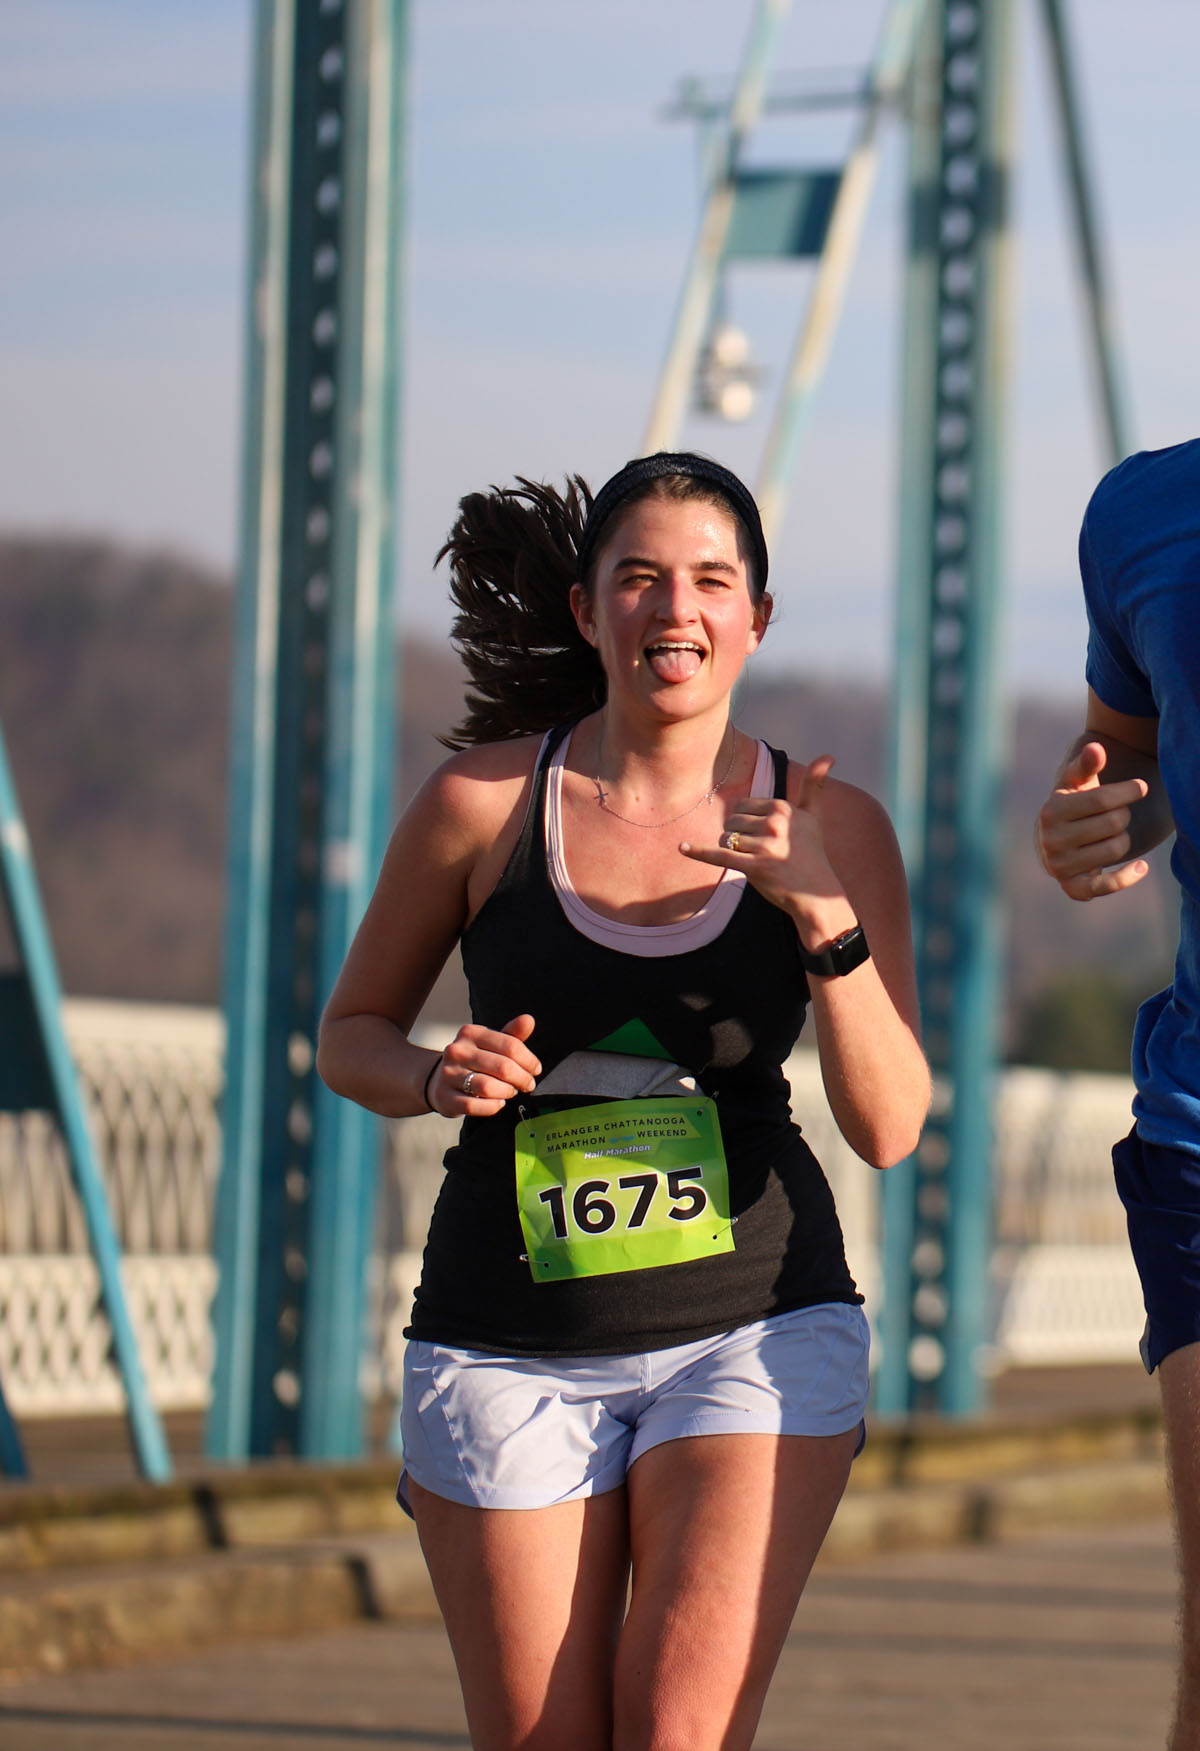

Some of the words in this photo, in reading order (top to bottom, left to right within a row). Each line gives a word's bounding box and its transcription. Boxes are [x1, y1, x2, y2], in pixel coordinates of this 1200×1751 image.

[546, 1125, 600, 1142] ERLANGER
[604, 1116, 686, 1131] CHATTANOOGA
[547, 1136, 606, 1154] MARATHON
[637, 1128, 688, 1138] WEEKEND
[605, 1144, 651, 1157] Marathon
[538, 1165, 709, 1239] 1675
